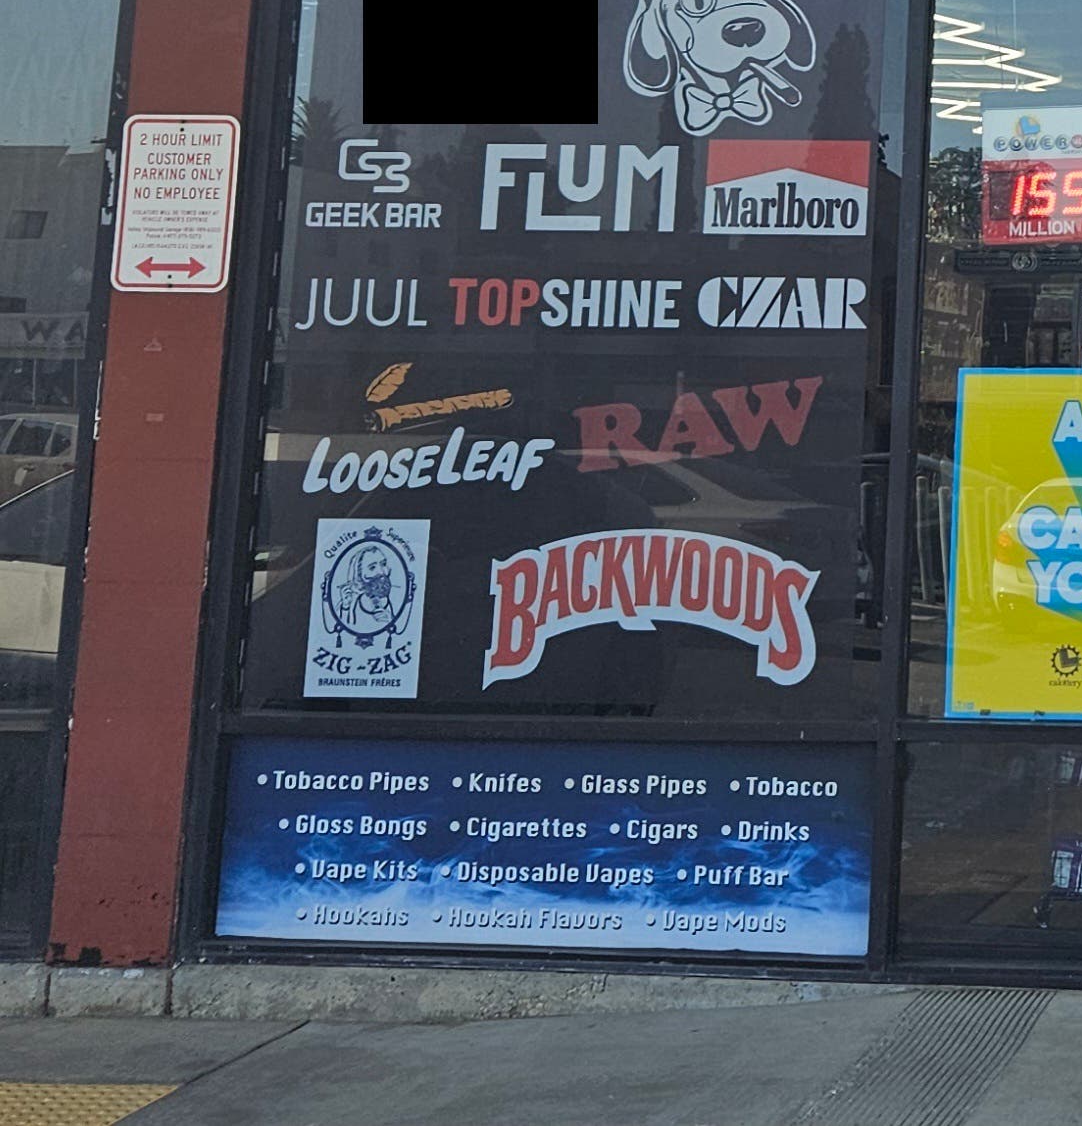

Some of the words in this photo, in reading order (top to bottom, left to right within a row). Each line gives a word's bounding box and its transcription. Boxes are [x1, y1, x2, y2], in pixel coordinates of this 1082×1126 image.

[140, 134, 147, 146] 2
[152, 134, 186, 146] HOUR
[191, 134, 223, 146] LIMIT
[147, 152, 211, 165] CUSTOMER
[133, 168, 186, 181] PARKING
[191, 168, 224, 181] ONLY
[133, 187, 150, 199] NO
[156, 187, 220, 200] EMPLOYEE
[480, 143, 680, 233] FLUM
[305, 202, 380, 227] GEEK
[385, 202, 442, 228] BAR
[709, 182, 860, 229] Marlboro
[1009, 220, 1075, 236] MILLION
[295, 277, 428, 331] JUUL
[697, 276, 867, 330] CZAR
[572, 376, 823, 473] RAW
[489, 534, 811, 672] BACKWOODS
[318, 678, 368, 687] BRAUNSTEIN
[273, 770, 364, 791] Tobacco
[369, 771, 430, 795] Pipes
[468, 772, 543, 793] Knifes
[581, 774, 640, 794] Glass
[646, 775, 707, 798] Pipes
[746, 776, 839, 798] Tobacco
[359, 815, 428, 840] Bongs
[466, 817, 587, 842] Cigarettes
[626, 819, 699, 845] Cigars
[738, 821, 810, 842] Drinks
[311, 859, 367, 883] Vape
[372, 860, 419, 881] Kits
[457, 862, 579, 887] Disposable
[585, 864, 655, 888] Vapes
[693, 865, 745, 886] Puff
[749, 866, 789, 886] Bar
[313, 904, 410, 926] Hookahs
[449, 906, 532, 928] Hookah
[539, 908, 623, 930] Flavors
[662, 909, 718, 935] Vape
[724, 911, 787, 933] Mods
